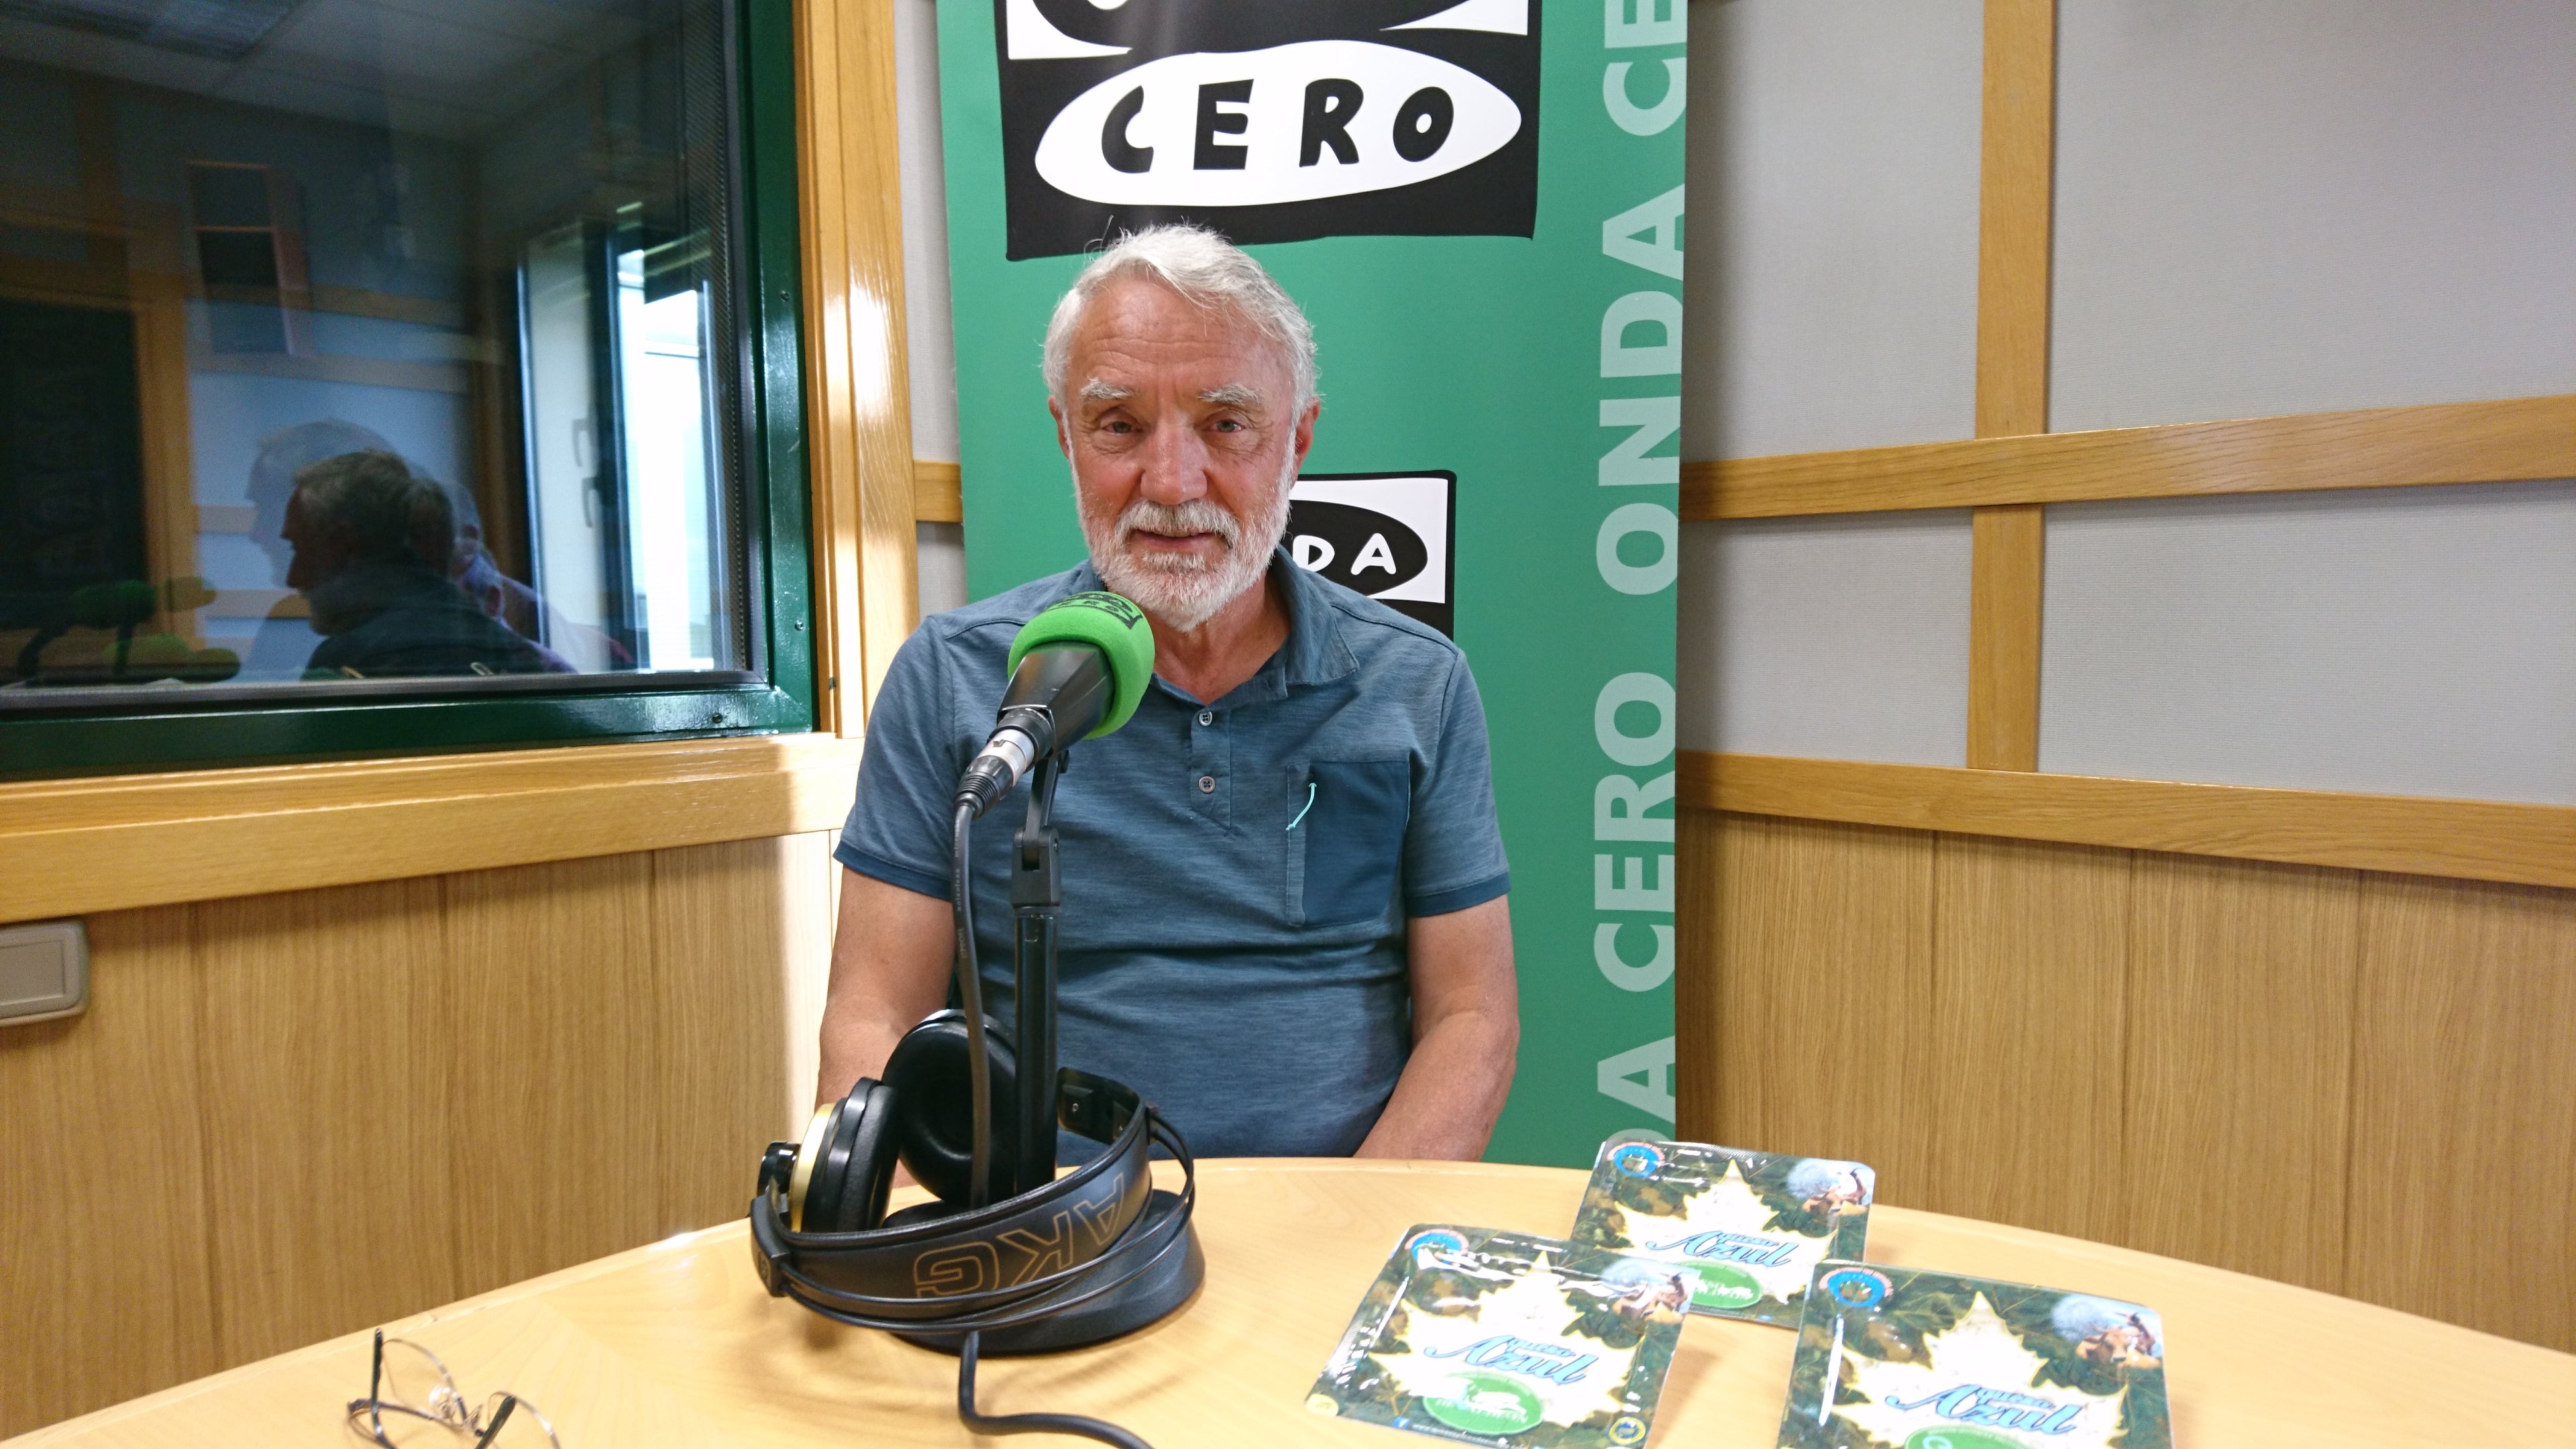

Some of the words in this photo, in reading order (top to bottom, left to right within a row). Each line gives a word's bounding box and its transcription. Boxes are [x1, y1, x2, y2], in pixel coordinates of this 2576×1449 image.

[1603, 0, 1688, 136] CE
[1101, 77, 1454, 174] CERO
[1596, 183, 1686, 596] ONDA
[1292, 533, 1397, 576] DA
[1594, 672, 1676, 992] CERO
[913, 1171, 1125, 1299] AKG
[1645, 1230, 1799, 1267] Azul
[1424, 1335, 1599, 1385] Azul
[1884, 1384, 2083, 1435] Azul
